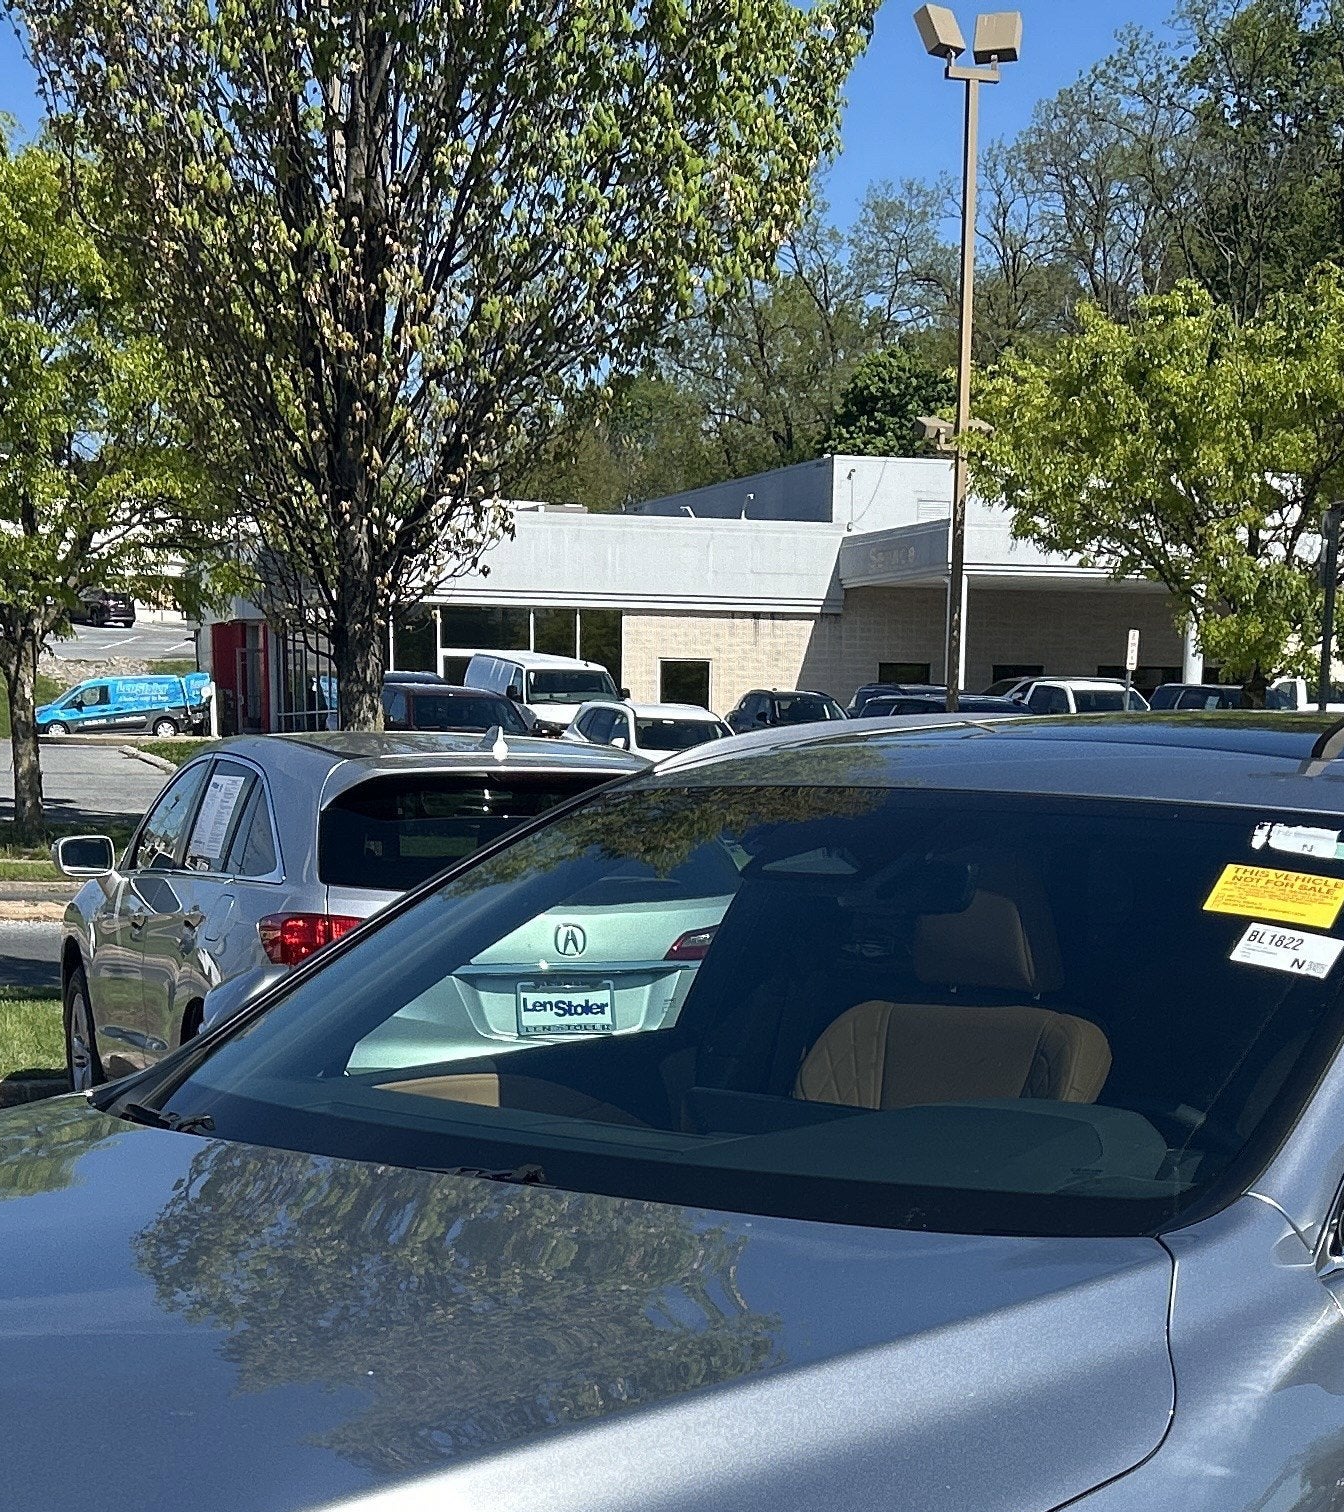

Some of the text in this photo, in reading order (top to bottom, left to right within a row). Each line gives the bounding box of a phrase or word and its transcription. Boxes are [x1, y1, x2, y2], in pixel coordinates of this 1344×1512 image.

[1231, 875, 1337, 895] NOT FOR SALE
[1234, 867, 1344, 889] THIS VEHICLE
[1290, 958, 1307, 970] N
[523, 997, 609, 1017] LenStoler
